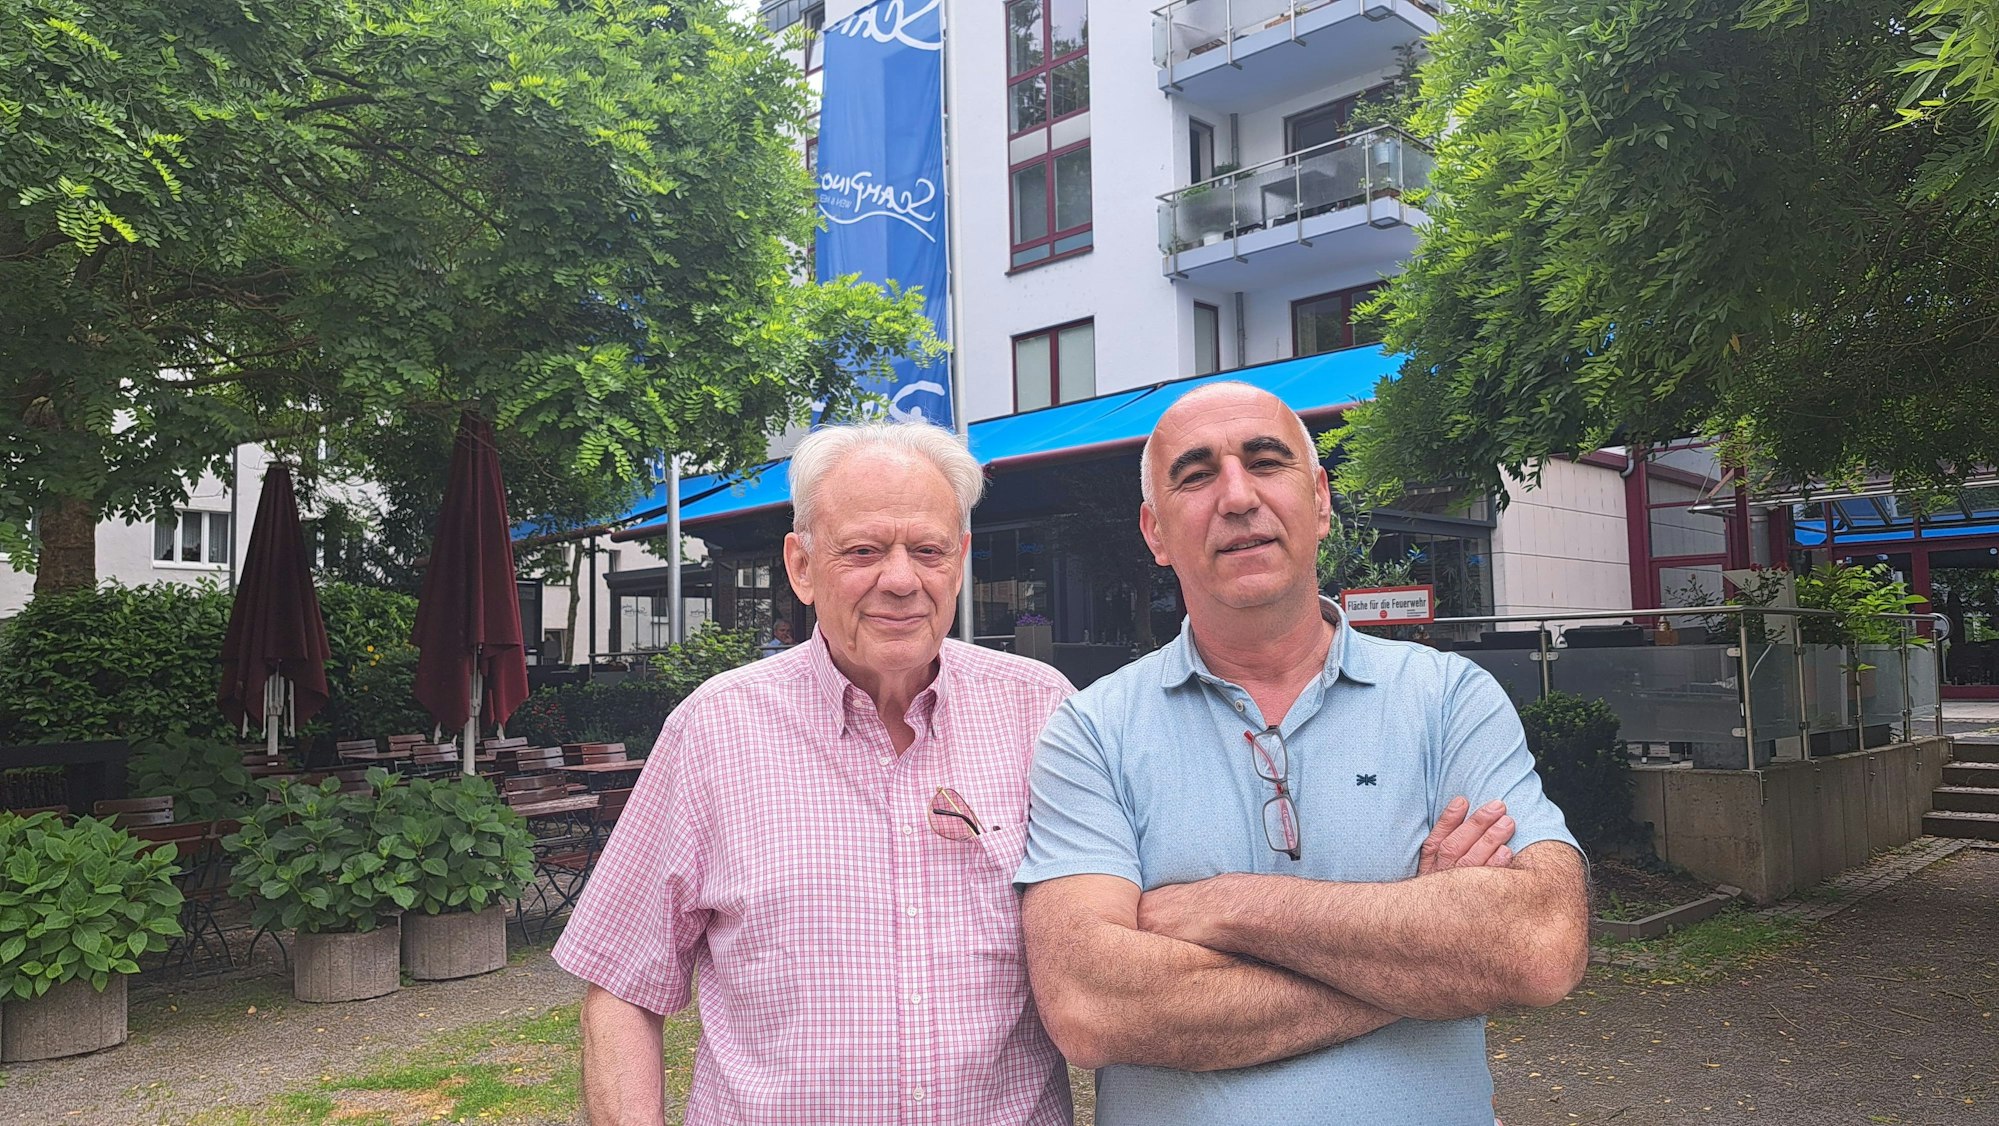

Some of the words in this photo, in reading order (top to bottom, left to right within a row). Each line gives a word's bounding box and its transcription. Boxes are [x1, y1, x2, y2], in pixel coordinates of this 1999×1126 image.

[1347, 600, 1368, 611] Fläche
[1369, 599, 1379, 610] für
[1380, 599, 1390, 609] die
[1391, 597, 1427, 609] Feuerwehr
